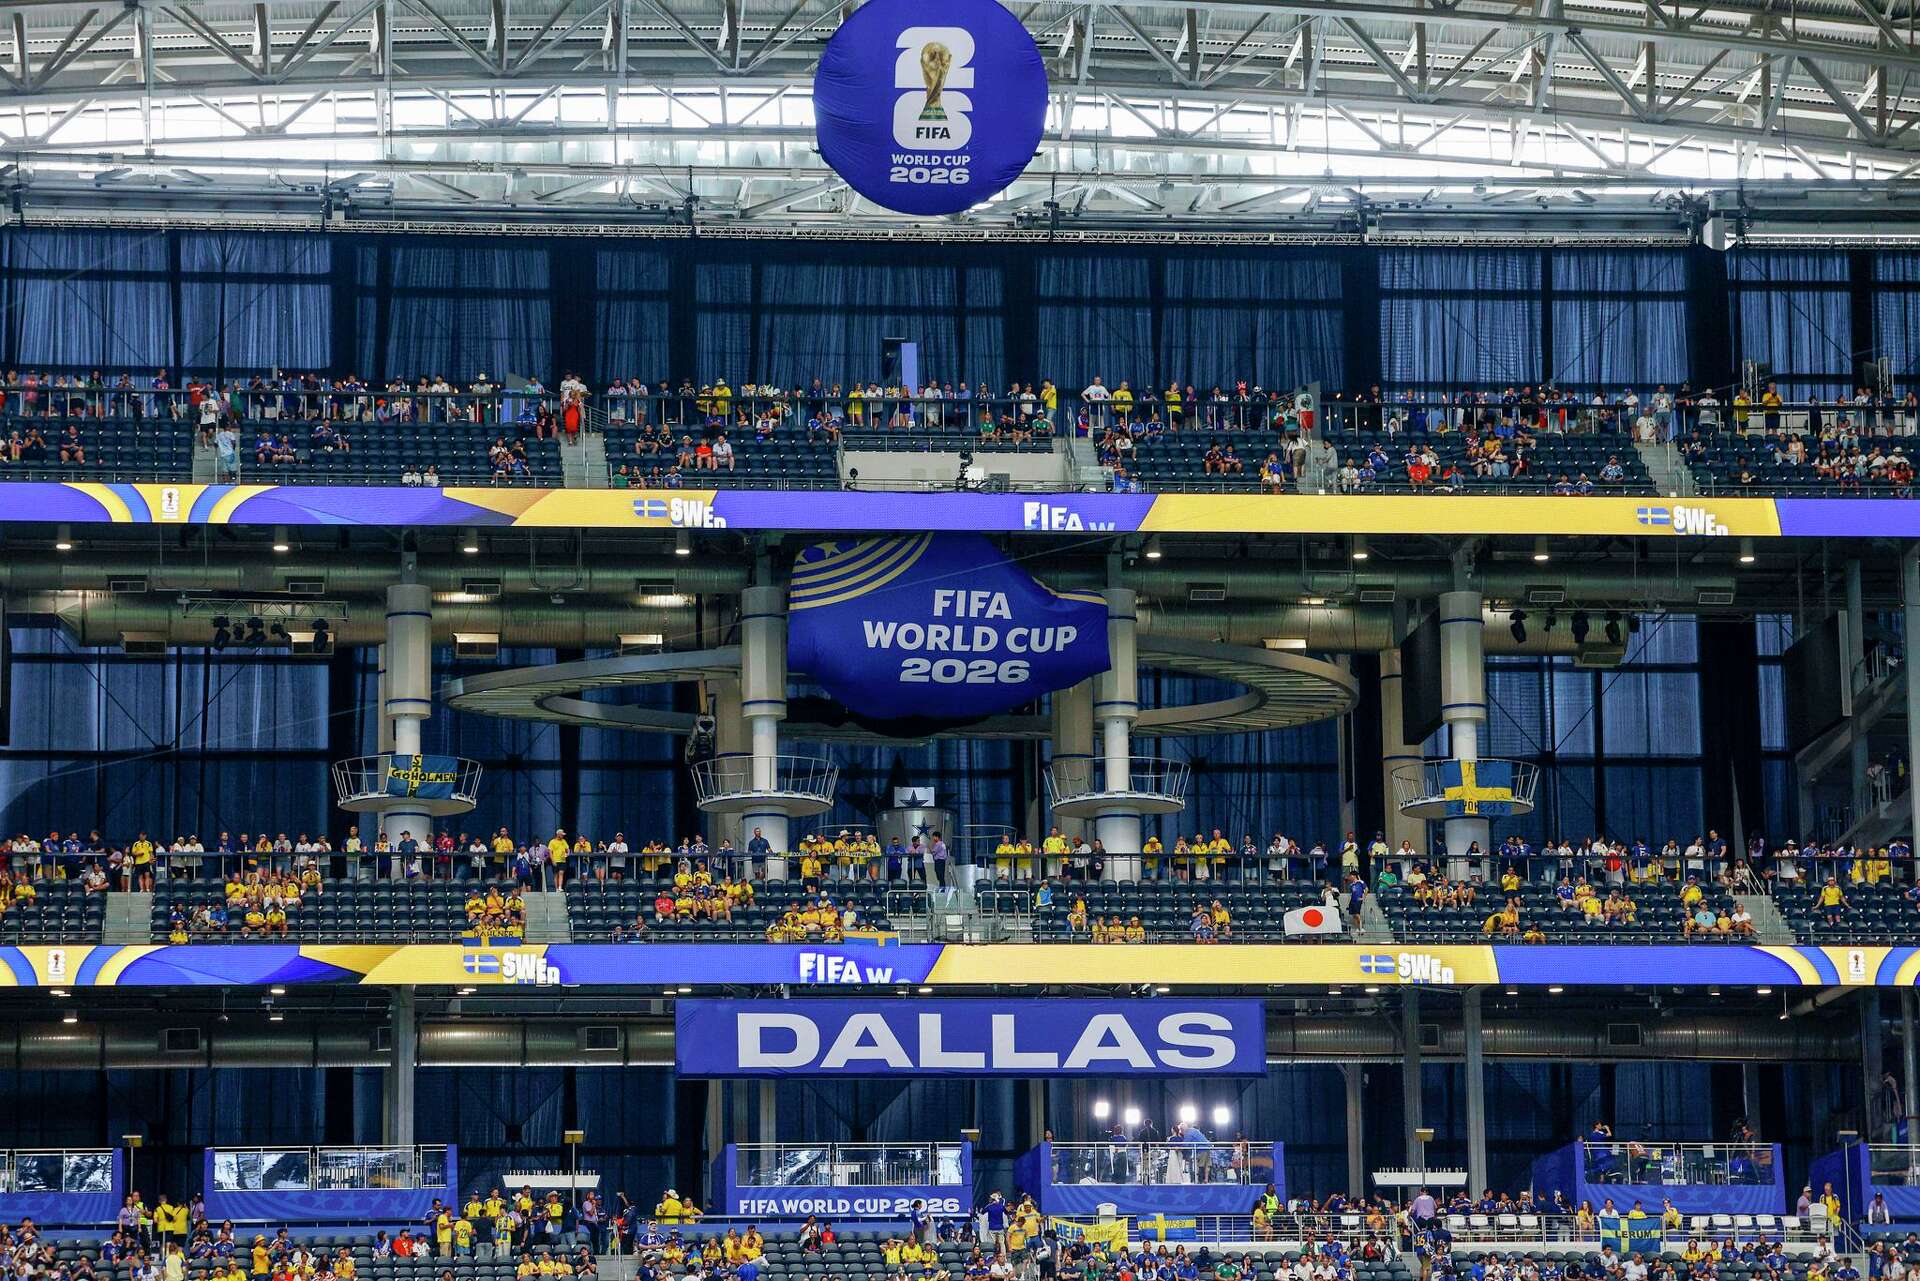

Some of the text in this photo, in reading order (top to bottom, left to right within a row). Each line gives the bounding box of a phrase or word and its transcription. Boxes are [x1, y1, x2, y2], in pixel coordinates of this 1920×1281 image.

[916, 127, 950, 139] FIFA
[891, 154, 970, 166] WORLD CUP
[890, 167, 970, 184] 2026
[1024, 502, 1083, 531] FIFA
[933, 589, 1012, 620] FIFA
[863, 621, 1077, 653] WORLD CUP
[900, 658, 1030, 684] 2026
[800, 952, 862, 983] FIFA
[737, 1012, 1237, 1069] DALLAS
[739, 1199, 779, 1214] FIFA
[781, 1199, 850, 1214] WORLD
[854, 1199, 891, 1214] CUP
[1615, 1230, 1652, 1239] LERUM
